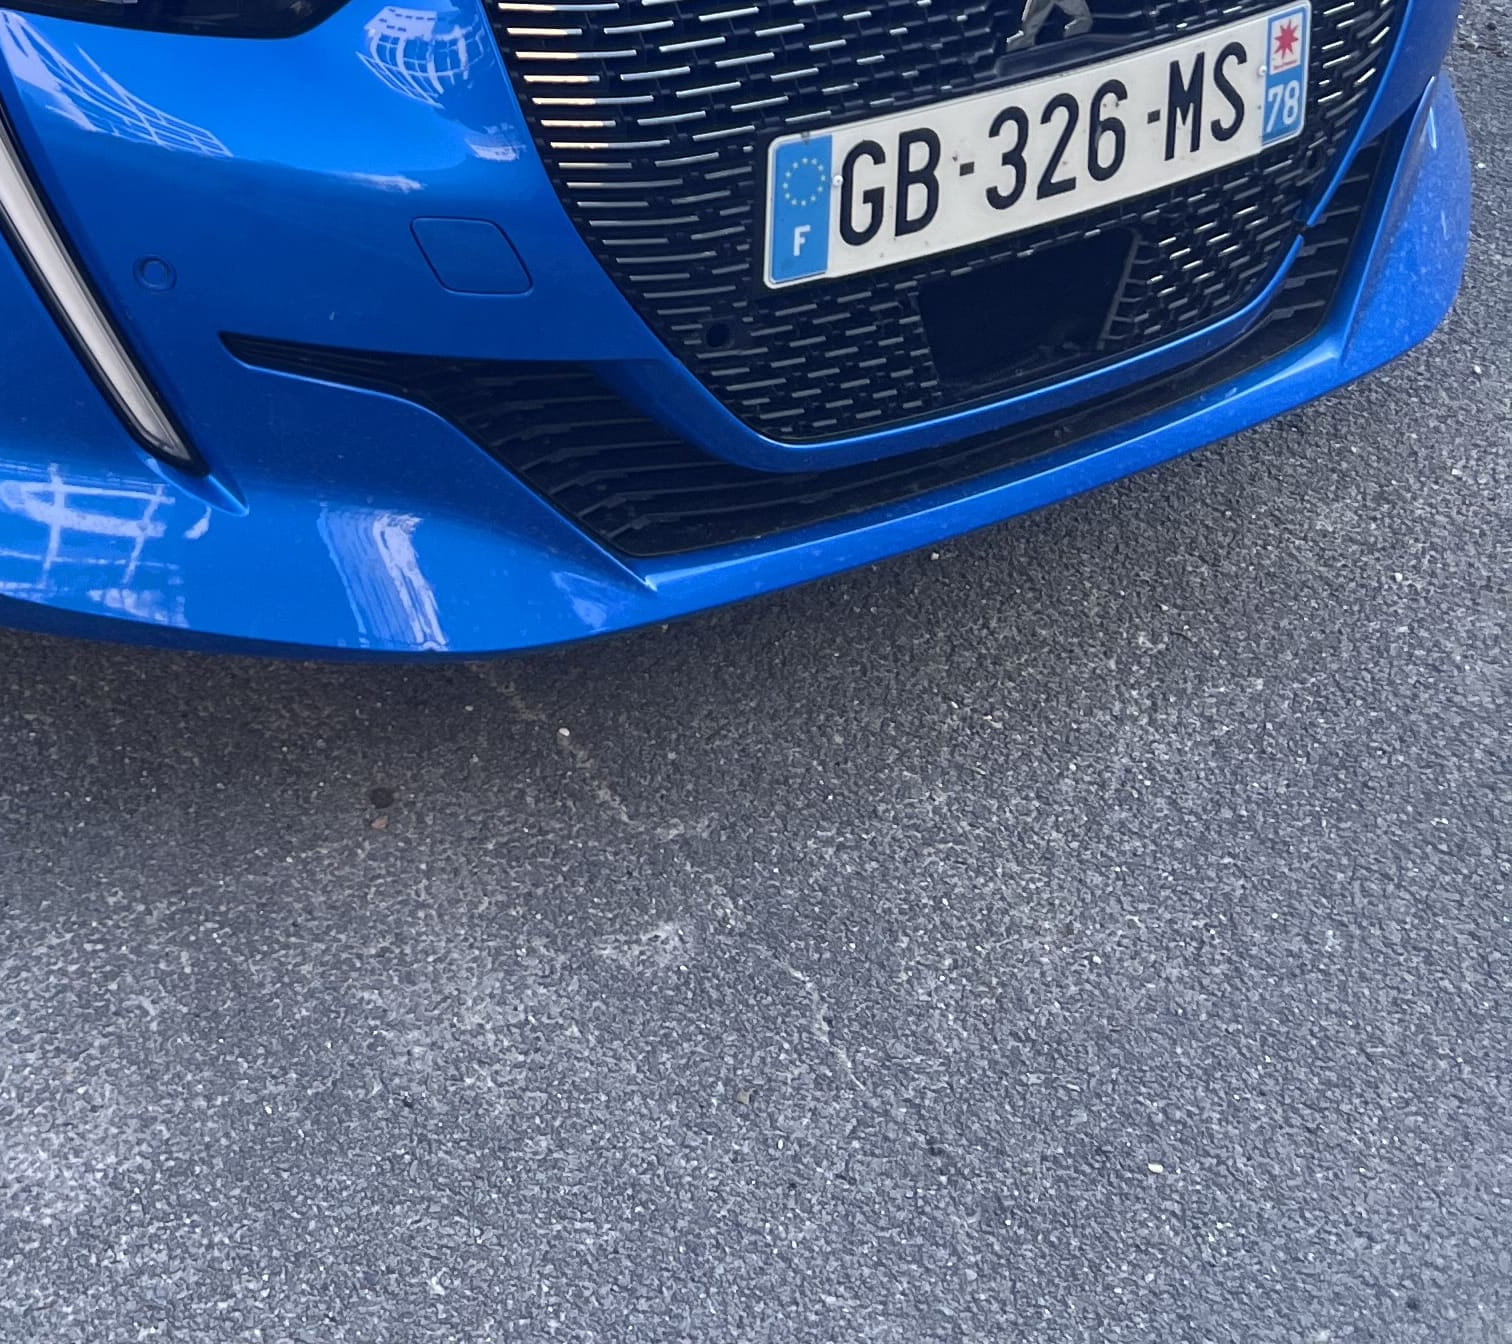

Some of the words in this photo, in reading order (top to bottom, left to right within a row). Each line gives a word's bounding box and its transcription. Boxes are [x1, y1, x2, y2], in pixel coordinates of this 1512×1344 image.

[1266, 79, 1300, 133] 78
[839, 41, 1248, 247] GB-326-MS
[793, 224, 811, 257] F
